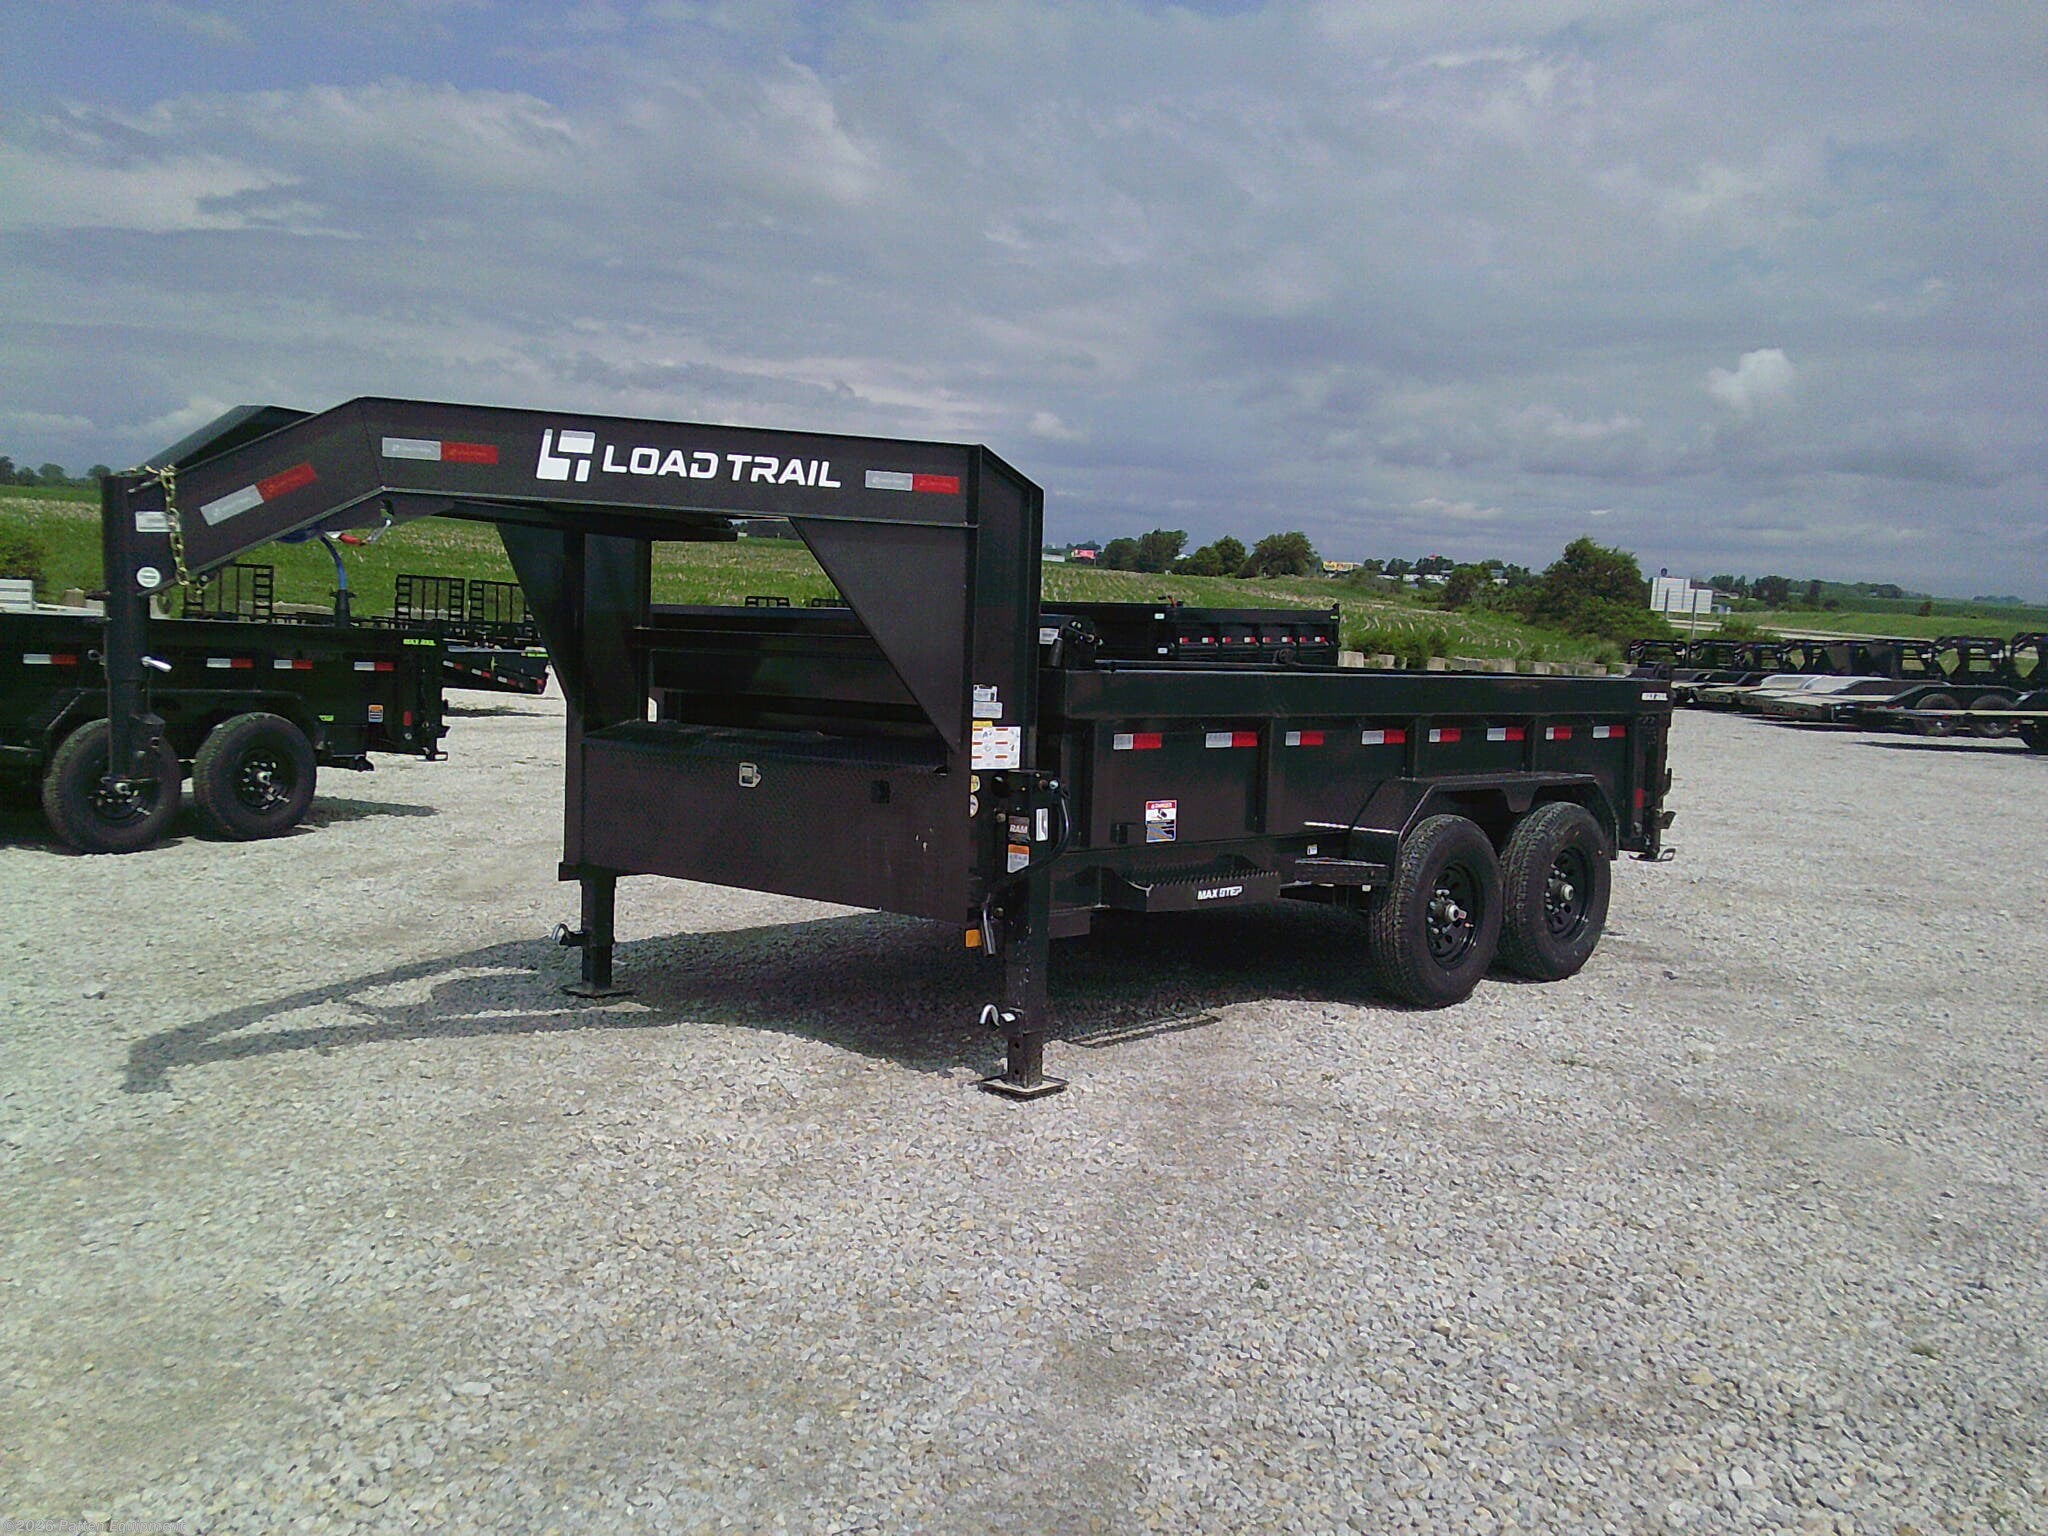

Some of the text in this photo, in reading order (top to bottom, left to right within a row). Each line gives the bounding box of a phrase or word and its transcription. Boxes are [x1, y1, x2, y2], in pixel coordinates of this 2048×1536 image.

[602, 444, 719, 480] LOAD
[726, 453, 842, 489] TRAIL
[1009, 824, 1029, 834] RAM
[1197, 888, 1219, 900] MAX
